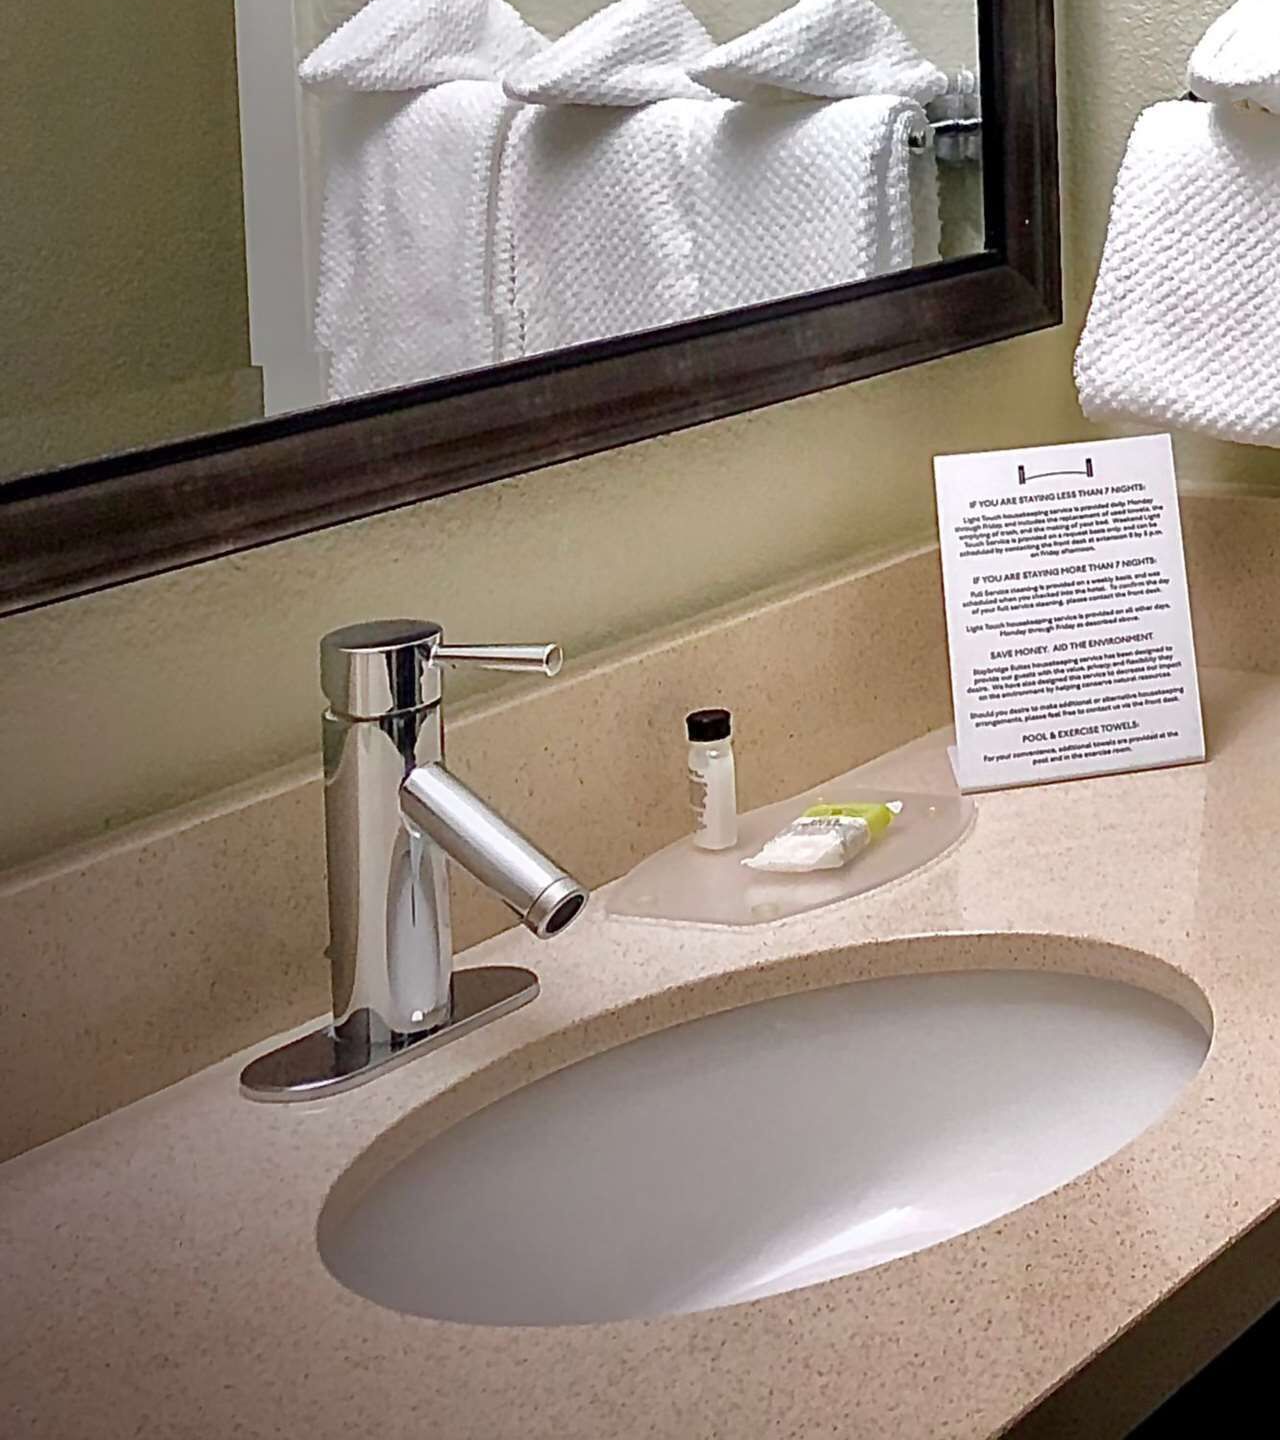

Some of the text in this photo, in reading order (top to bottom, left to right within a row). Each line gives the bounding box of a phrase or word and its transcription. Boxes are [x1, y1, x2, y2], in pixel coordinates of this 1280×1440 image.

[969, 501, 977, 509] IF
[978, 499, 999, 508] YOU
[999, 497, 1017, 506] ARE
[1018, 493, 1056, 504] STAYING
[1056, 491, 1077, 500] LESS
[1077, 488, 1104, 498] THAN
[1104, 487, 1110, 495] 7
[972, 576, 980, 584] IF
[981, 574, 1003, 583] YOU
[1003, 572, 1021, 581] ARE
[1022, 567, 1060, 579] STAYING
[1060, 564, 1087, 574] MORE
[1087, 561, 1114, 571] THAN
[990, 649, 1013, 659] SAVE
[1052, 642, 1068, 652] AID
[1069, 640, 1087, 650] THE
[1088, 632, 1154, 647] ENVIRONMENT
[1022, 733, 1048, 744] POOL
[1049, 732, 1057, 740] &
[1057, 726, 1100, 739] EXERCISE
